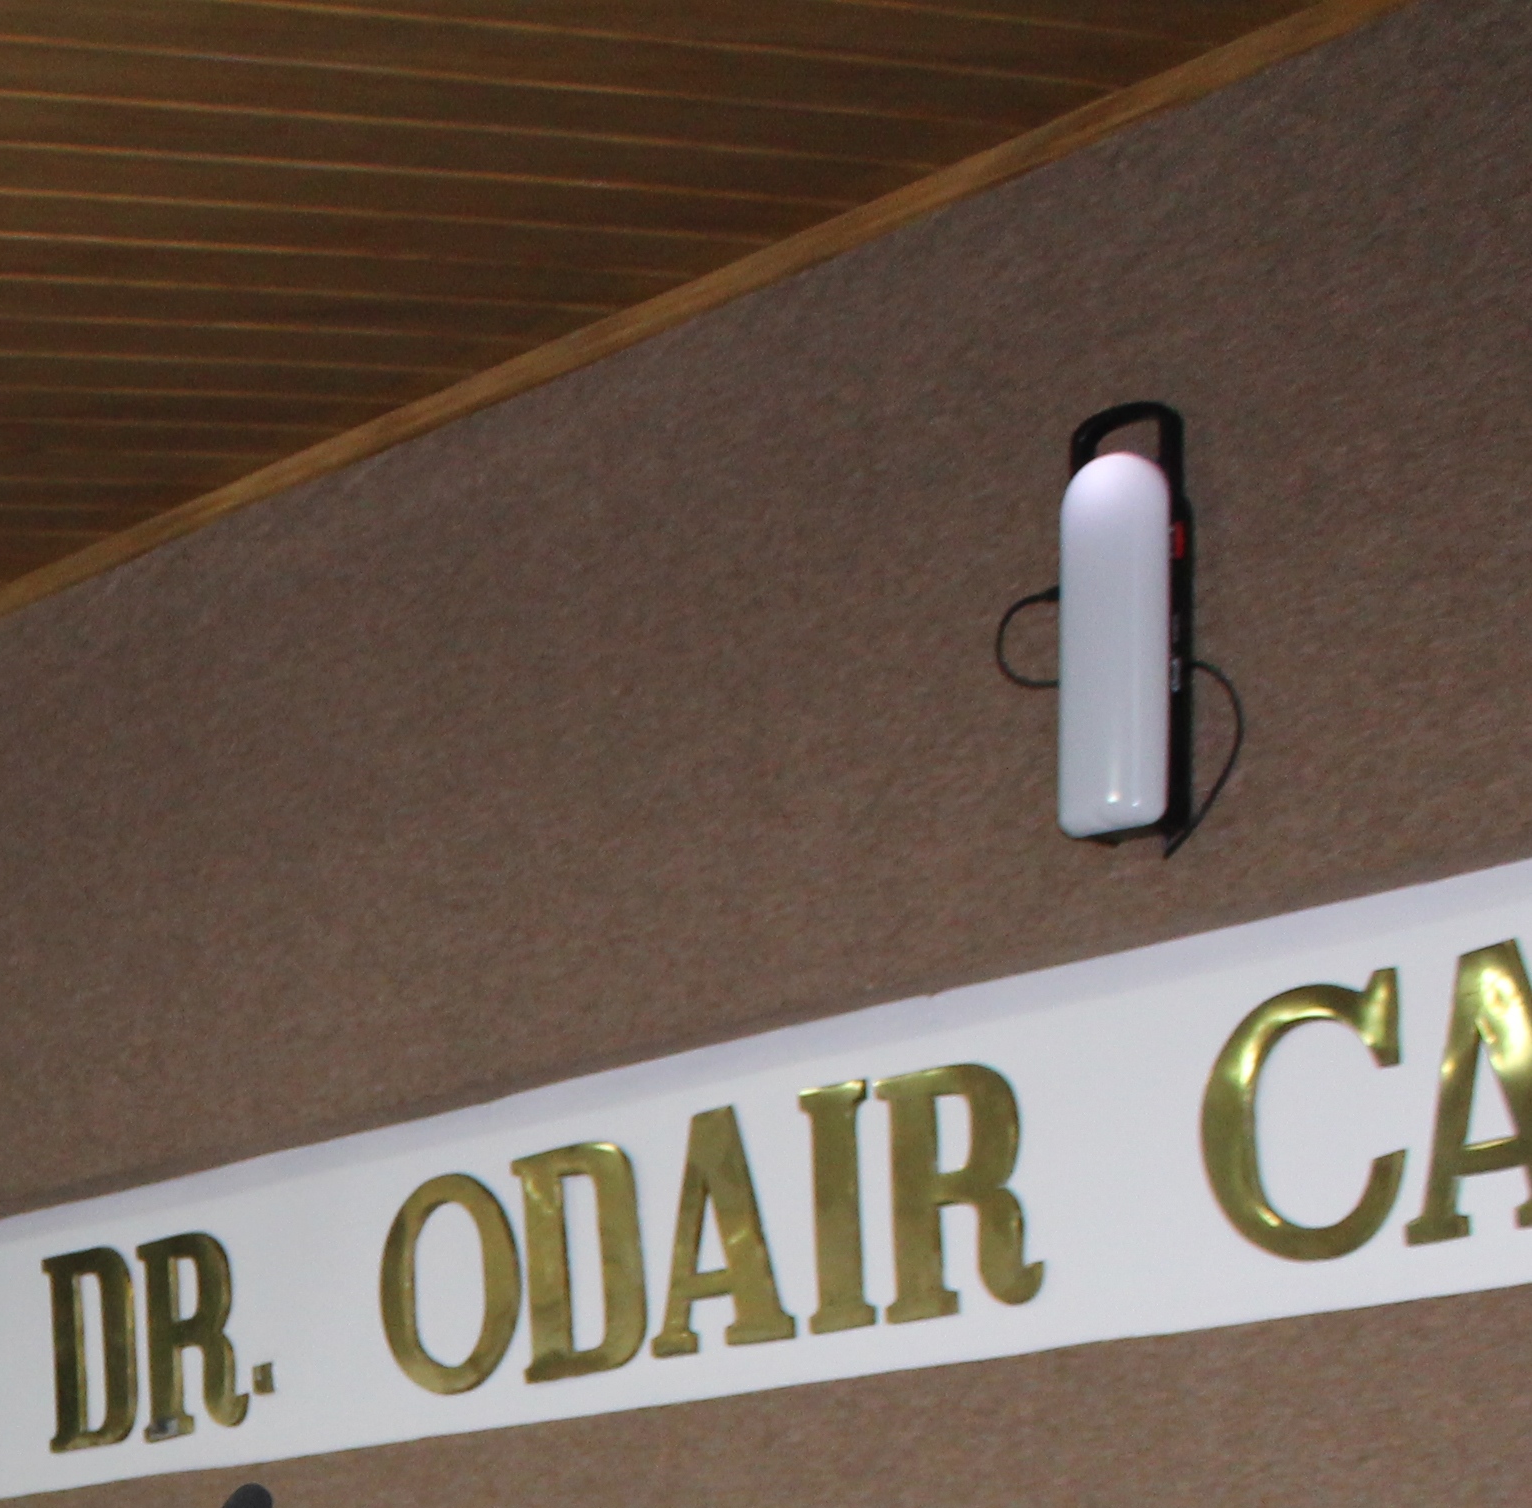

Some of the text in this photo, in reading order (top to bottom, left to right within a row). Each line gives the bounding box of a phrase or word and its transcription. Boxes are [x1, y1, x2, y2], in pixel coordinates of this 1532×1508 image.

[41, 1231, 275, 1454] DR.
[379, 1063, 1044, 1395] ODAIR
[1198, 938, 1532, 1262] CA
